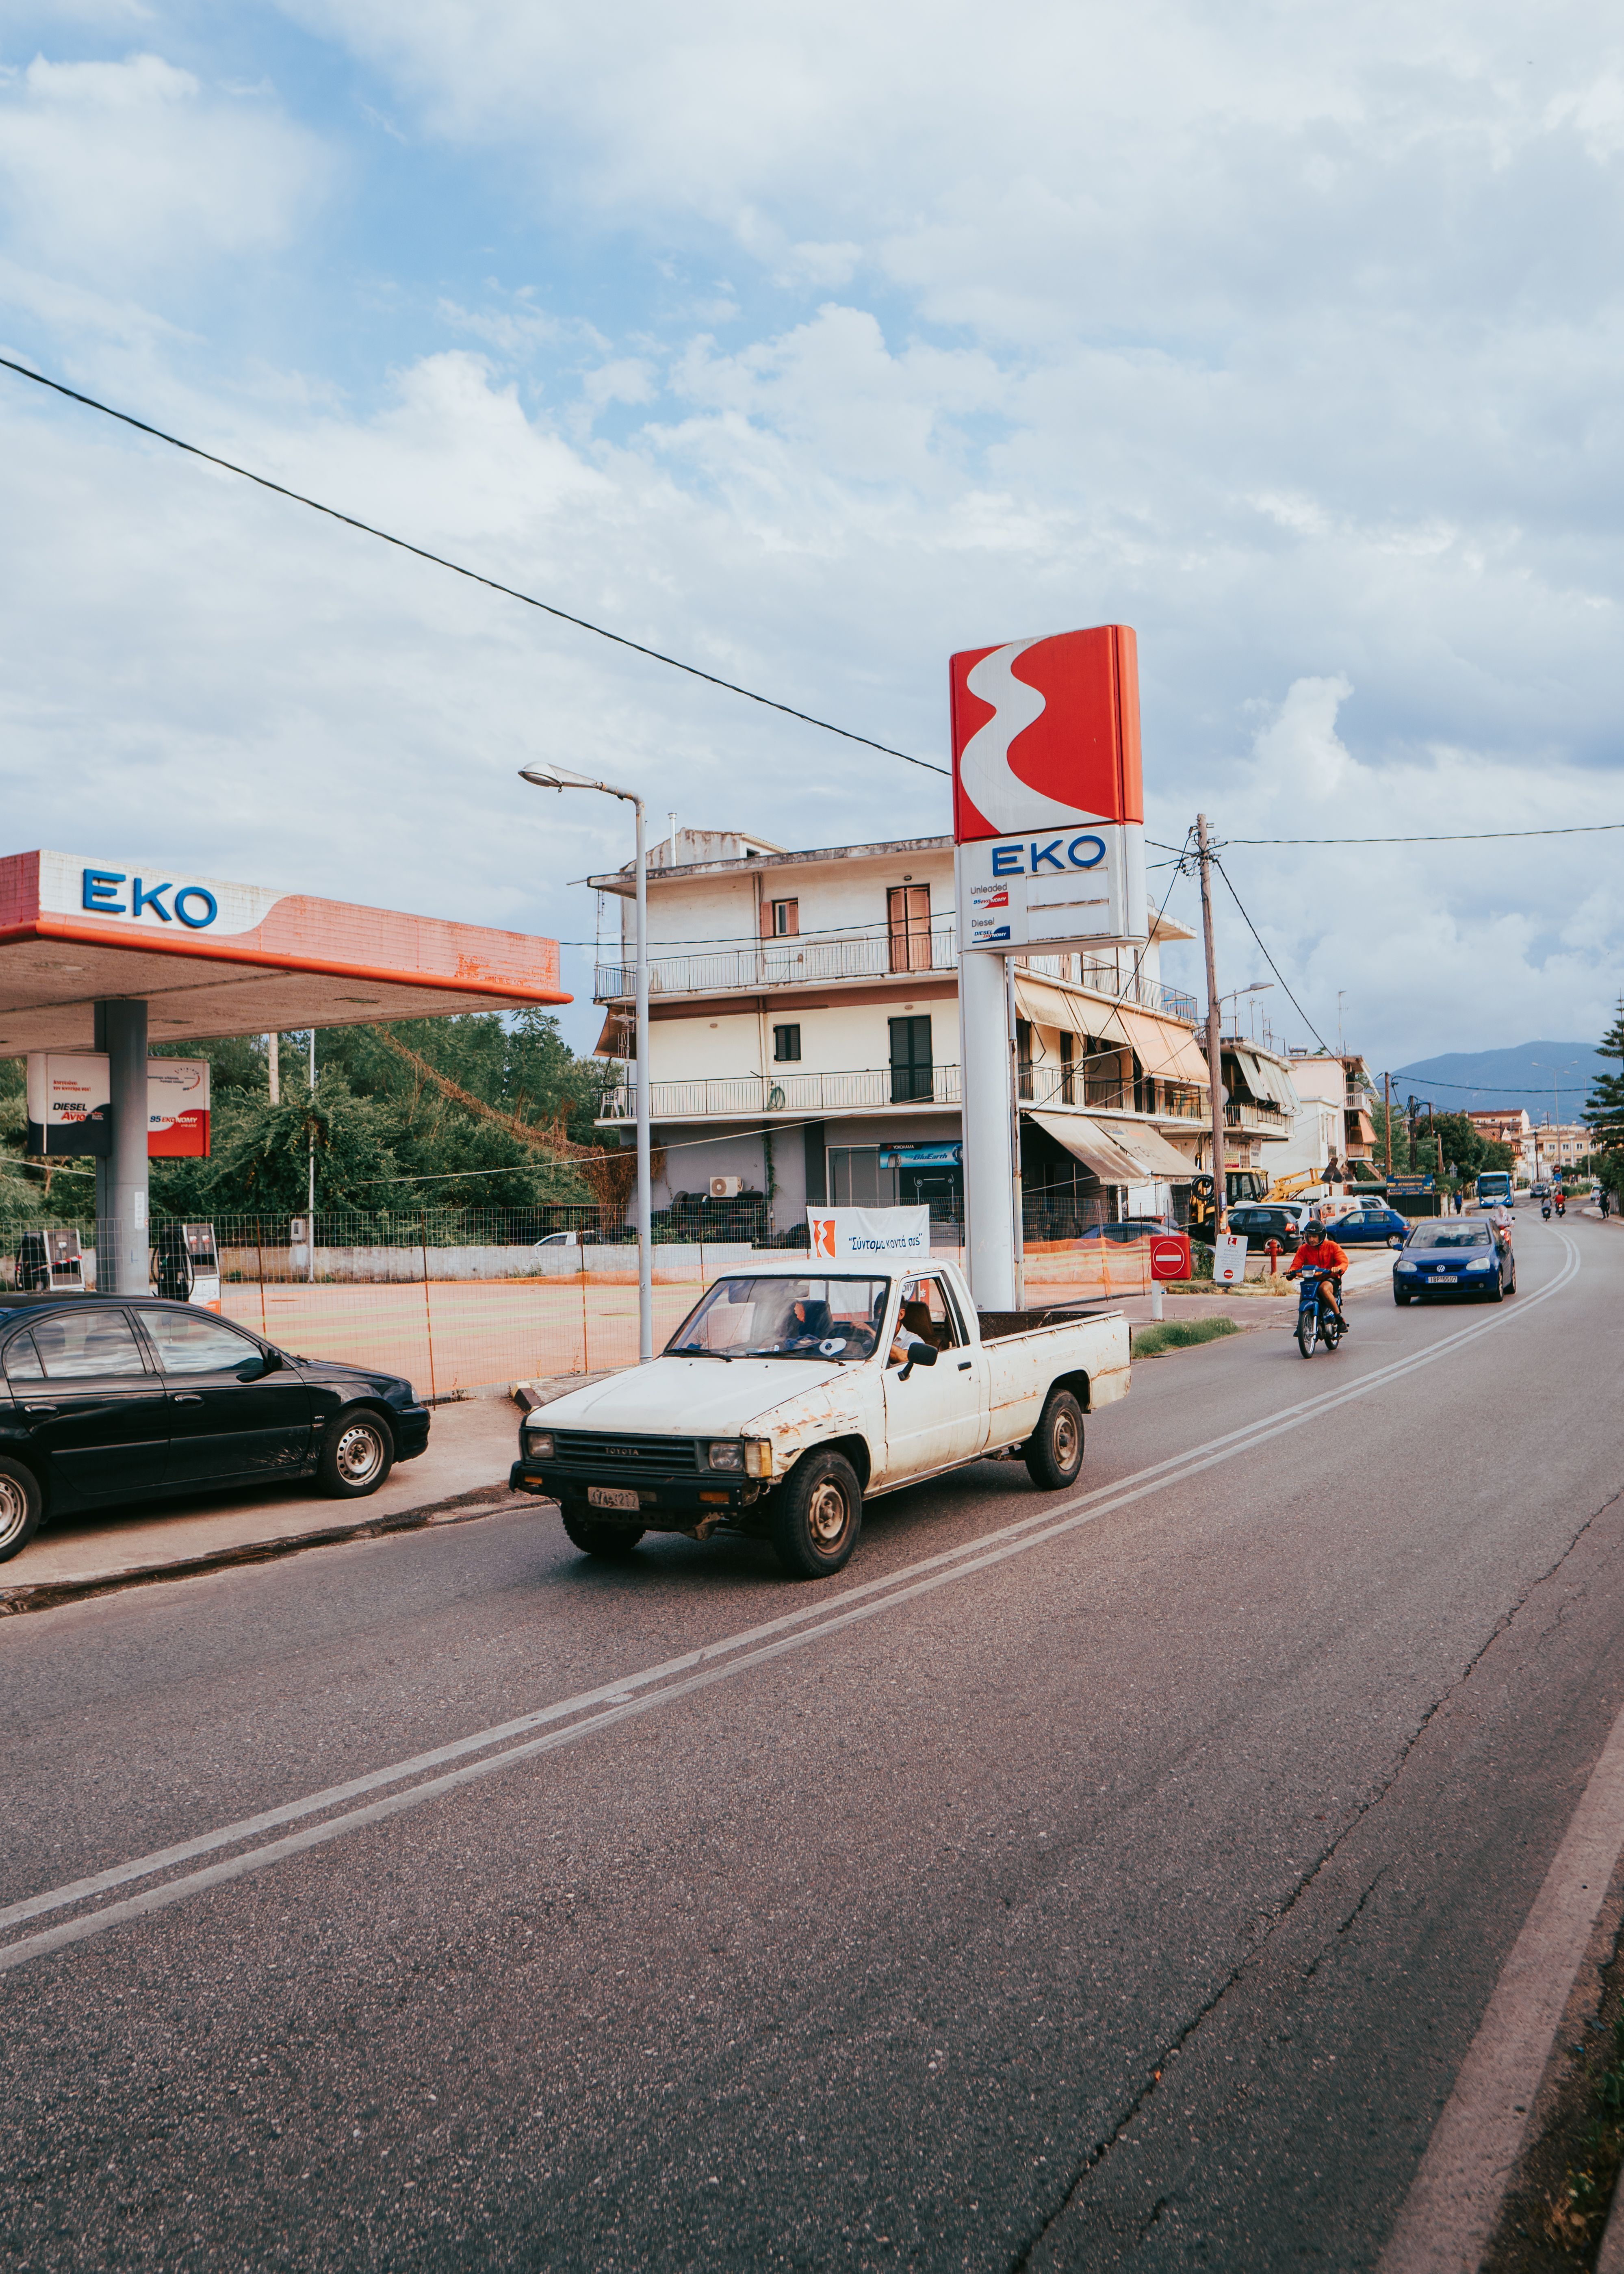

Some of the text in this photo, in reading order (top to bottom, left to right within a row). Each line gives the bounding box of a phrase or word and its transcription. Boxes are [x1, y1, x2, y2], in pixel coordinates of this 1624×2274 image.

[992, 835, 1107, 877] EKO
[971, 882, 1007, 894] Unleaded
[83, 868, 218, 928] EKO
[971, 917, 995, 927] Diesel
[53, 1103, 87, 1111] DIESEL
[886, 1235, 906, 1249] κοντά
